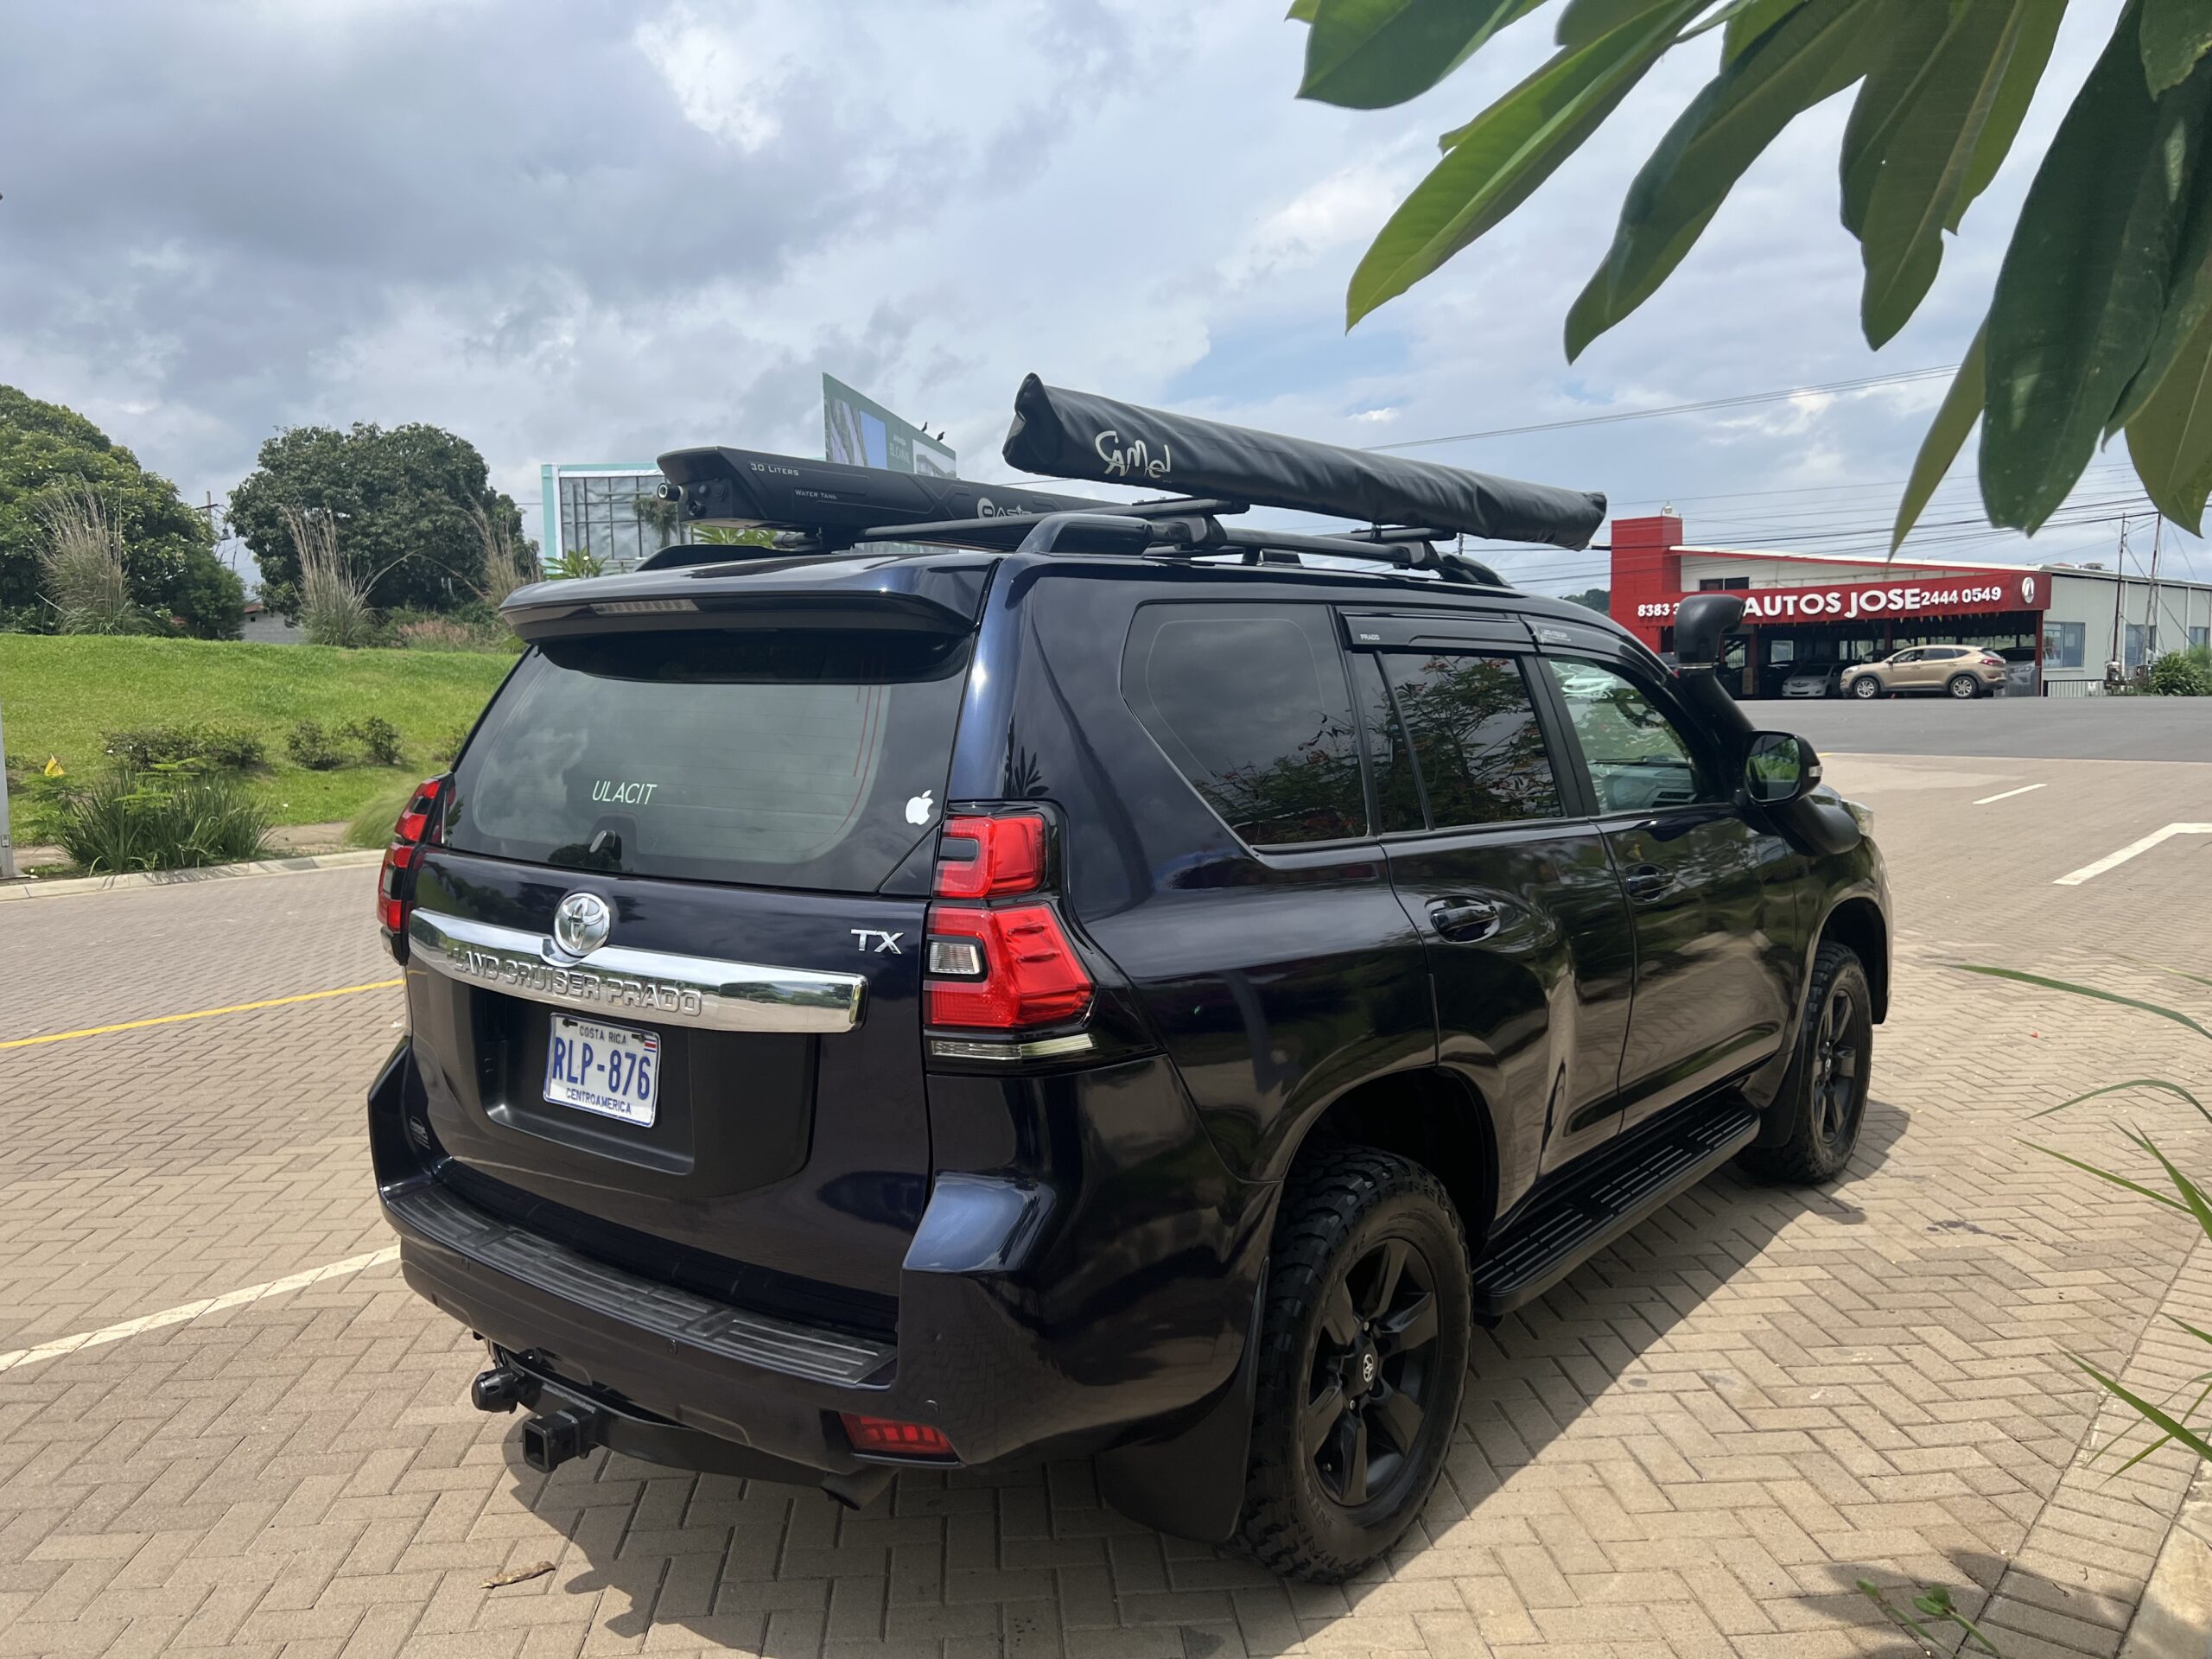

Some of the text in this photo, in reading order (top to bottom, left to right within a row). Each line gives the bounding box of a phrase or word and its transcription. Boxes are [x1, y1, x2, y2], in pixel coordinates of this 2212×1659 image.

[750, 462, 765, 472] 30
[1743, 588, 1921, 619] AUTOS JOSE
[1921, 587, 2002, 606] 2444 0549
[1637, 603, 1670, 617] 8383
[592, 780, 658, 804] ULACIT
[851, 929, 904, 954] TX
[454, 947, 702, 1017] LAND CRUISER PRADO
[579, 1026, 627, 1045] COSTA RICA
[553, 1037, 651, 1100] RLP-876
[566, 1087, 632, 1115] CENTROAMERICA
